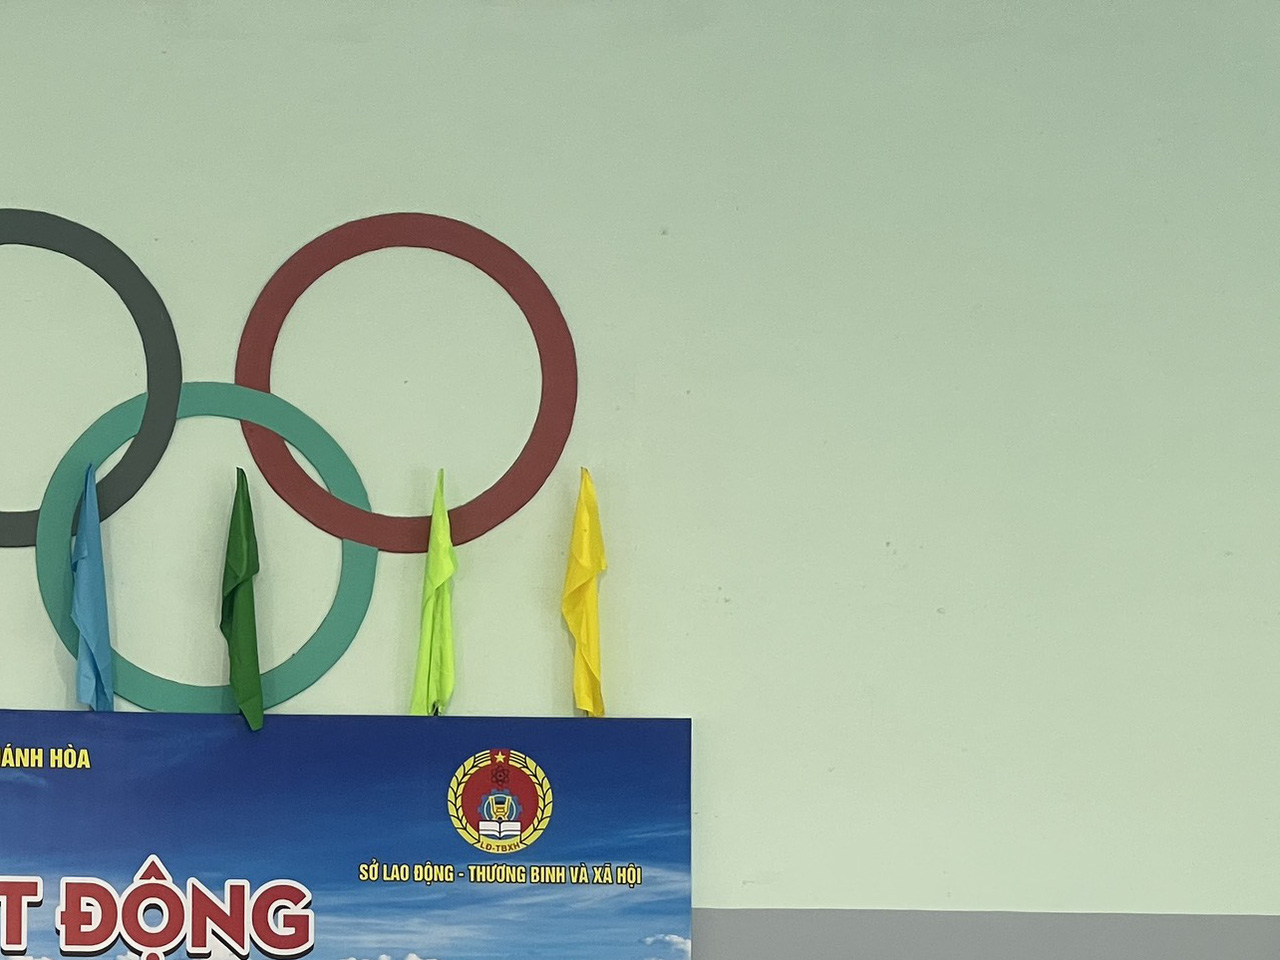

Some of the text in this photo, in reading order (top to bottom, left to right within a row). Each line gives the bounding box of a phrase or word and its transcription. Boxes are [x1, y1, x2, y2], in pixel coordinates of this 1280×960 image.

[50, 743, 91, 769] HÒA
[359, 858, 379, 881] SỞ
[383, 864, 409, 881] LAO
[414, 861, 454, 886] ĐỘNG
[468, 864, 526, 883] THƯƠNG
[530, 866, 566, 884] BINH
[570, 862, 589, 884] VÀ
[592, 863, 613, 884] XÃ
[617, 862, 642, 888] HỘI
